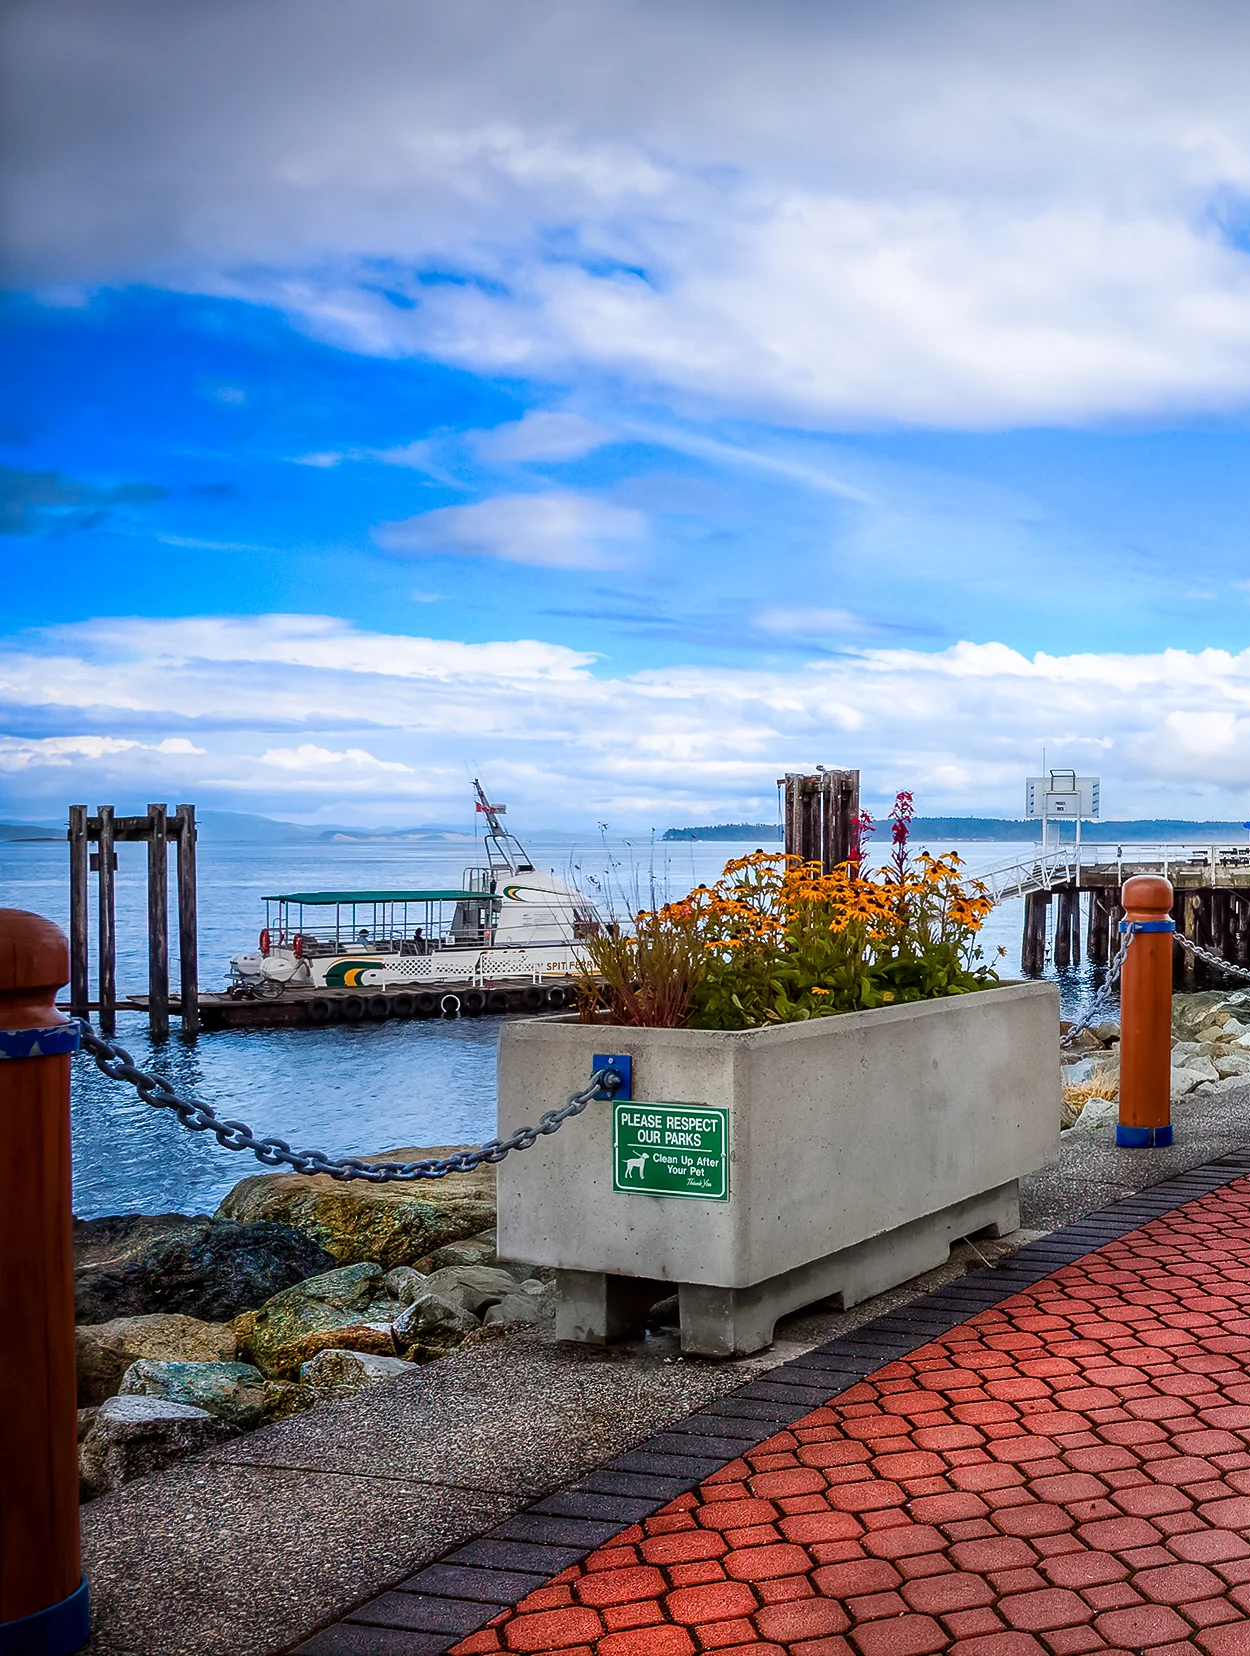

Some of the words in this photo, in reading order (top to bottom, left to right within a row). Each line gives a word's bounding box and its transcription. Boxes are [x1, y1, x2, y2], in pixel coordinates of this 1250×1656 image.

[546, 961, 566, 970] SPIT
[569, 960, 599, 970] FERR
[621, 1113, 662, 1128] PLEASE
[666, 1116, 718, 1132] RESPECT
[637, 1130, 661, 1144] OUR
[665, 1132, 702, 1147] PARKS
[653, 1153, 677, 1164] Clean
[681, 1156, 694, 1167] Up
[697, 1157, 719, 1168] After
[668, 1165, 687, 1175] Your
[690, 1166, 705, 1177] Pet
